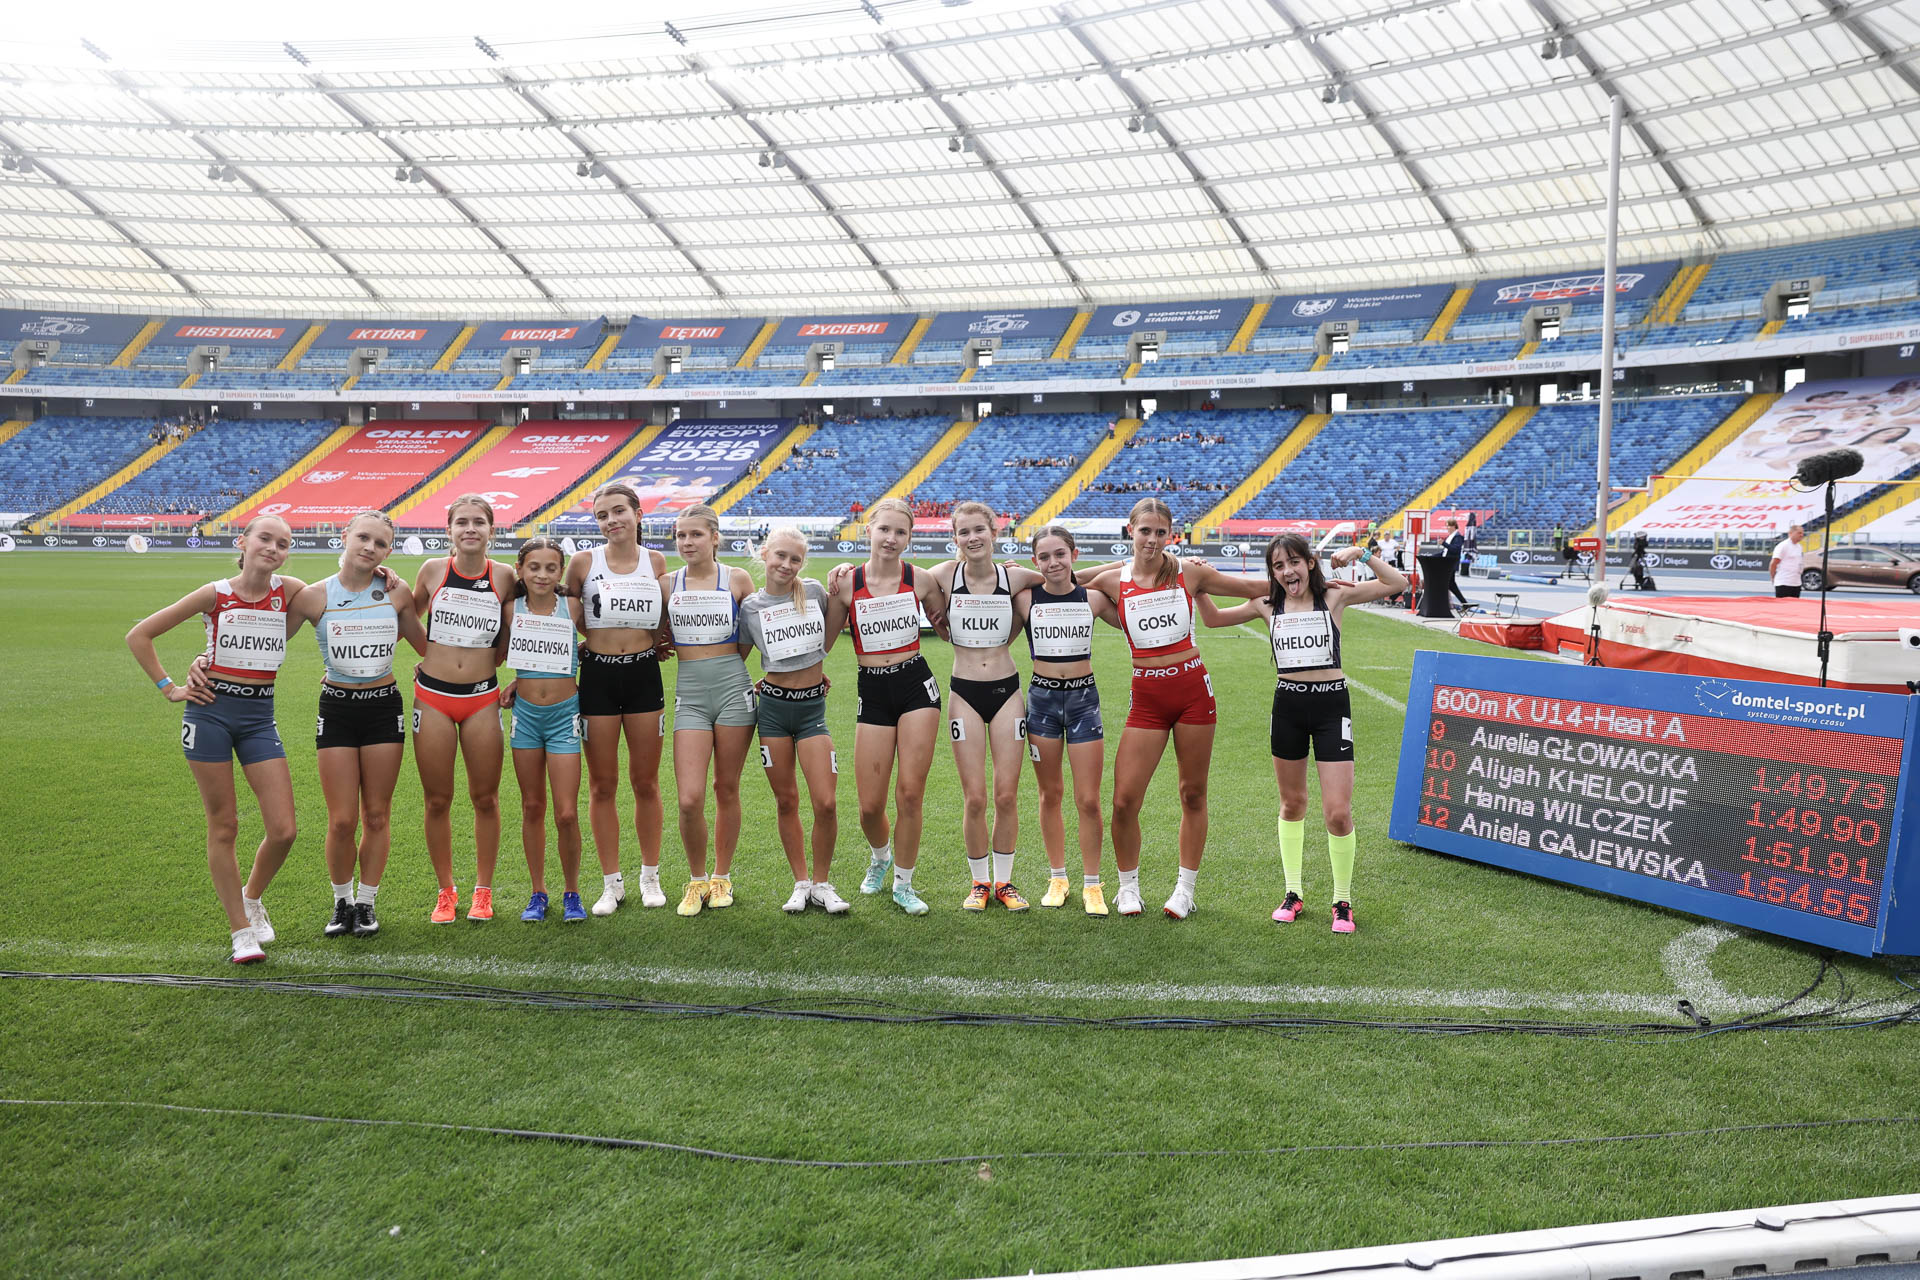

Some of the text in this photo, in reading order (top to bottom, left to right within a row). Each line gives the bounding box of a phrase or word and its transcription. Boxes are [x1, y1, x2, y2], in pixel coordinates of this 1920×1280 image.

[1148, 309, 1221, 317] superauto.pl
[1186, 314, 1220, 322] ŚLĄSKI
[186, 326, 278, 340] HISTORIA,
[356, 327, 417, 341] KTÓRA
[510, 327, 571, 342] WCIĄŻ
[668, 326, 718, 341] TĘTNI
[805, 322, 880, 336] ŻYCIEM!
[1900, 345, 1915, 358] 37
[1518, 362, 1543, 370] STADION
[1613, 369, 1625, 381] 36
[1403, 382, 1414, 392] 35
[1033, 394, 1043, 403] 33
[1210, 390, 1220, 399] 34
[85, 399, 94, 407] 27
[872, 398, 881, 407] 32
[366, 429, 472, 439] ORLEN
[522, 435, 611, 443] ORLEN
[667, 429, 776, 438] EUROPY
[655, 440, 760, 449] SILESIA
[638, 448, 755, 462] 2028
[1667, 503, 1816, 512] JESTEŚMY
[610, 598, 653, 613] PEART
[434, 609, 498, 633] STEFANOWICZ
[672, 613, 730, 627] LEWANDOWSKA
[860, 614, 918, 636] GŁOWACKA
[962, 617, 1000, 631] KLUK
[1138, 612, 1178, 631] GOSK
[765, 621, 823, 645] ŻYZNOWSKA
[1034, 625, 1090, 639] STUDNIARZ
[219, 634, 284, 652] GAJEWSKA
[511, 637, 570, 656] SOBOLEWSKA
[1274, 634, 1331, 651] KHELOUF
[331, 643, 394, 659] WILCZEK
[595, 654, 633, 664] NIKE
[866, 665, 900, 675] NIKE
[1144, 666, 1179, 678] PRO
[1184, 657, 1203, 672] NIK
[1031, 675, 1095, 689] PRO NIKE
[1277, 681, 1343, 693] PRO NIKE
[214, 682, 274, 697] PRO NI
[322, 685, 388, 700] PRO NIKE
[760, 681, 819, 700] PRO NIKE
[1731, 692, 1866, 720] domtel-sport.pl
[413, 712, 420, 729] 3
[1436, 688, 1687, 742] 600m K U14-Heat A
[1746, 710, 1845, 727] systemy pomiaru czasu
[182, 723, 191, 746] 2
[951, 720, 961, 740] 6
[1019, 719, 1025, 738] 6
[1431, 719, 1887, 811] 9 Aurelia GŁOWACKA 1:49.73
[1426, 748, 1882, 848] 10 Aliyah KHELOUF 1:49.90
[1423, 776, 1874, 886] 11 Hanna WILCZEK 1:51.91
[1419, 803, 1872, 922] 12 Aniela GAJEWSKA 1:54.55
